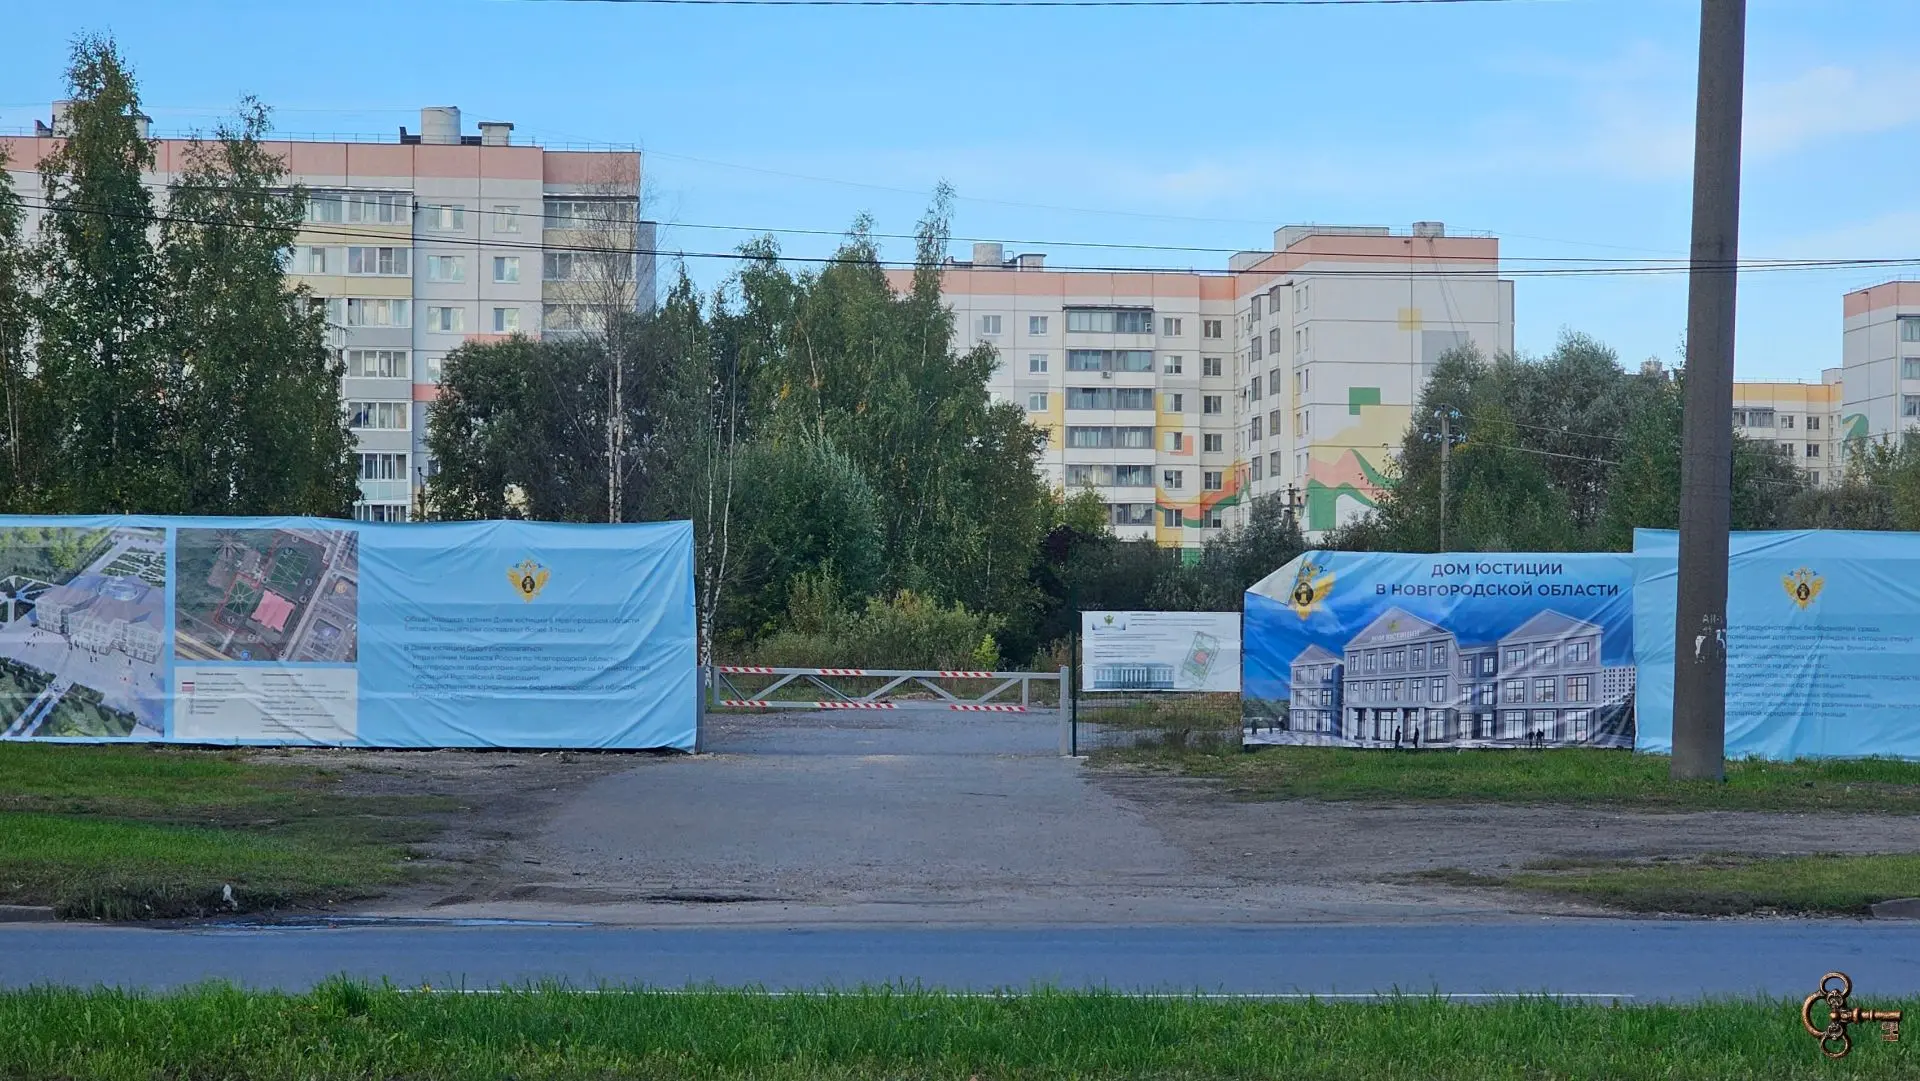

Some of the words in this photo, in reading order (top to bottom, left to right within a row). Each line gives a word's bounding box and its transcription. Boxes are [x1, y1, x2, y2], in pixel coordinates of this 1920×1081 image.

[1431, 563, 1470, 577] ДОМ
[1475, 563, 1562, 576] ЮСТИЦИИ
[1376, 583, 1386, 595] В
[1392, 582, 1533, 597] НОВГОРОДСКОЙ
[1536, 583, 1619, 597] ОБЛАСТИ
